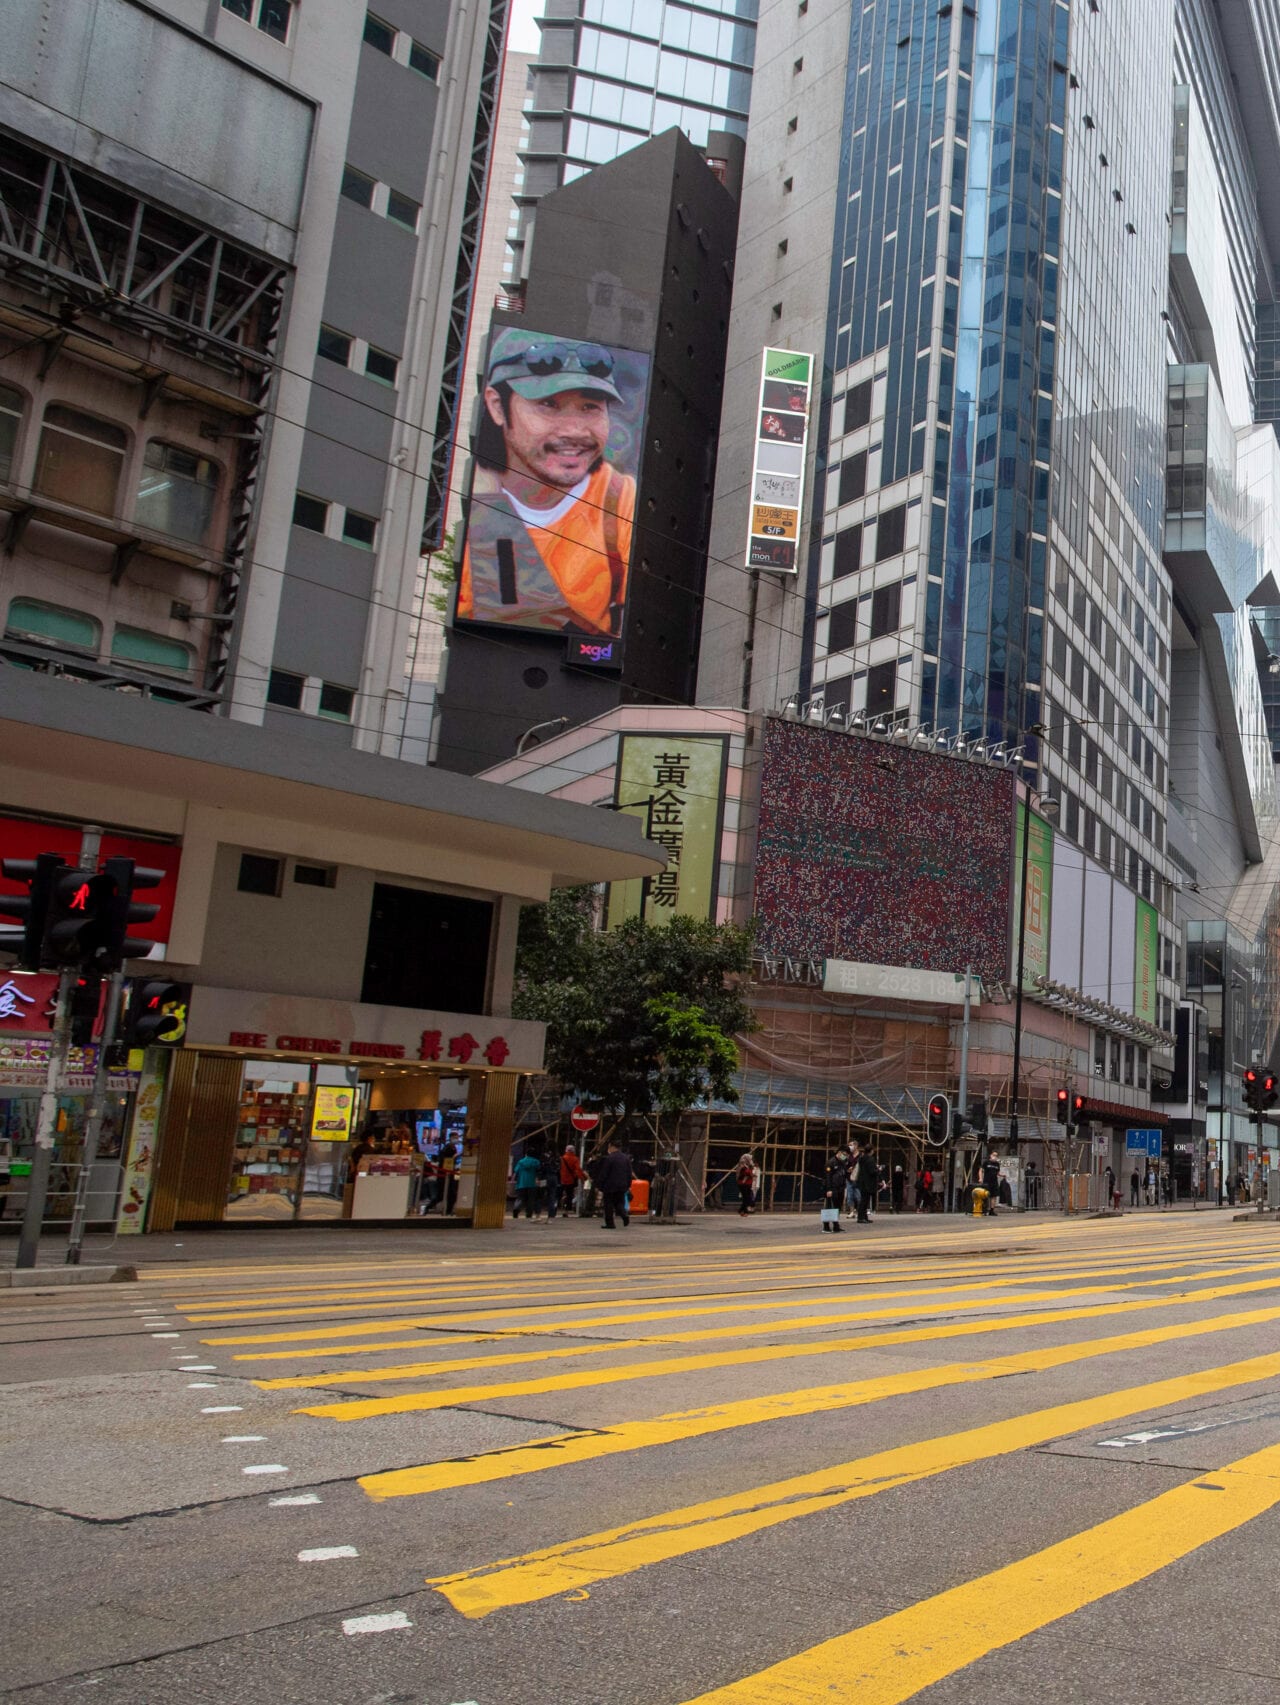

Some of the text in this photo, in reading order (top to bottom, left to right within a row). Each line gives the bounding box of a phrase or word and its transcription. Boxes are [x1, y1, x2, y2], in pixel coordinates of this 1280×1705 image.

[767, 526, 781, 534] 5/F
[580, 643, 612, 661] xgd
[878, 972, 920, 993] 2523
[229, 1032, 267, 1048] BEE
[276, 1035, 341, 1053] CHENG
